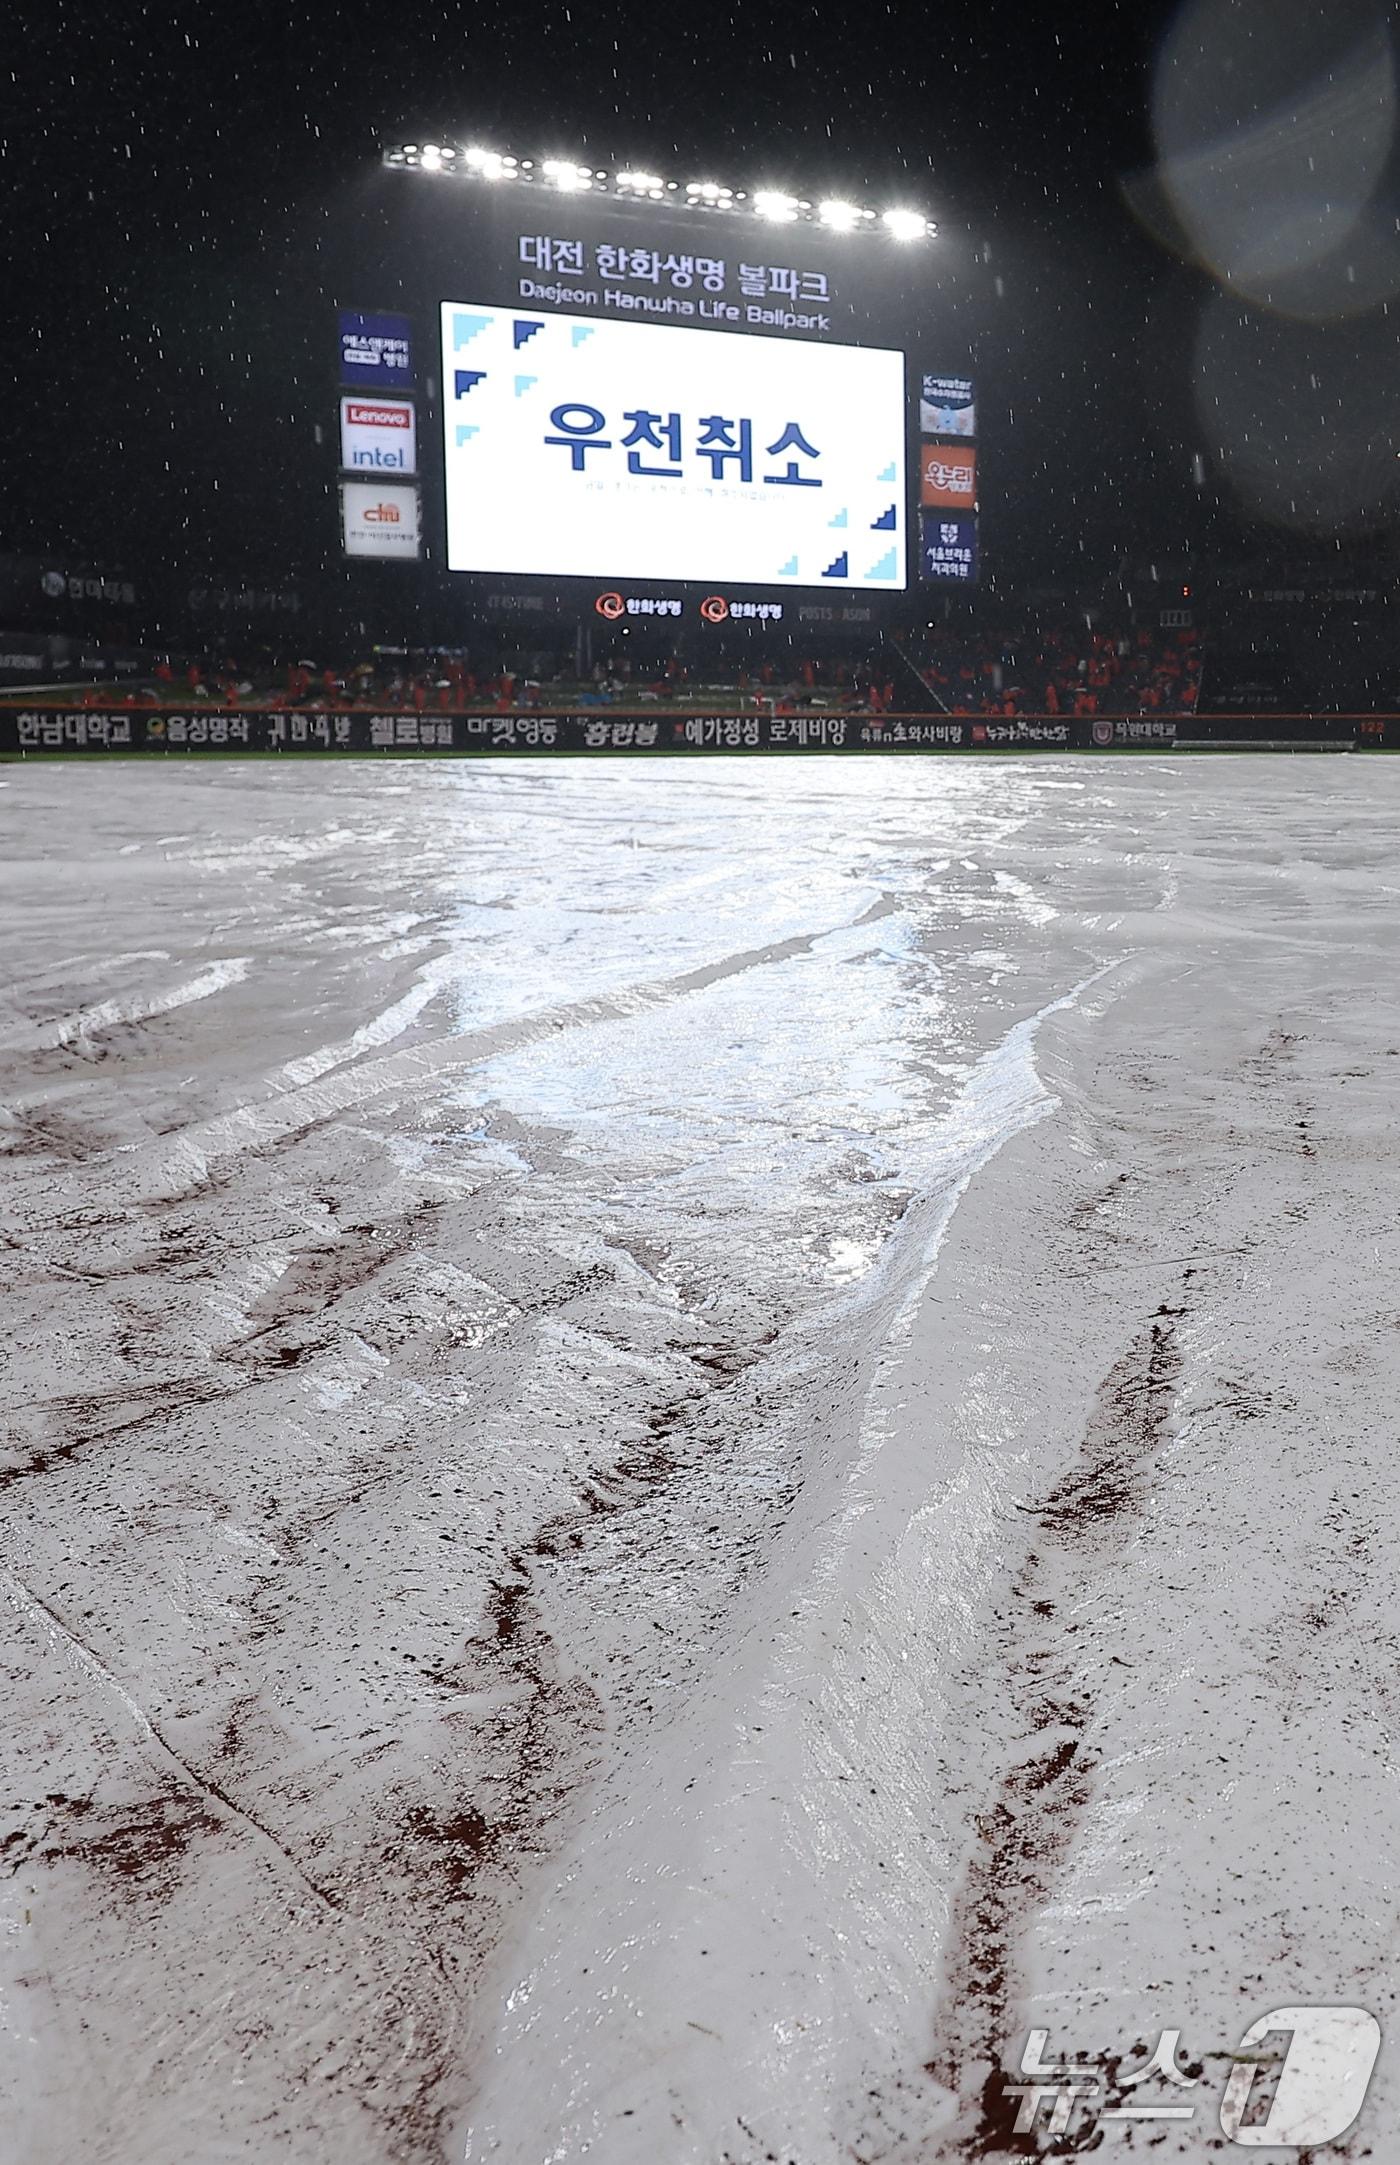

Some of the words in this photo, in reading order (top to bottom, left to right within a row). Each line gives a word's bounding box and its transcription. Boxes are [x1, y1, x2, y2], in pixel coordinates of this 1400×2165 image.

[519, 235, 585, 275] 대전
[595, 244, 725, 292] 한화생명
[738, 263, 831, 302] 볼파크
[519, 278, 597, 307] Daejeon
[604, 288, 694, 316] Hanwha
[699, 300, 740, 321] Life
[746, 304, 831, 331] Ballpark
[350, 407, 407, 425] Lenovo
[353, 445, 403, 468] intel
[544, 402, 822, 487] 우천취소
[626, 598, 682, 617] 한화생명
[729, 601, 783, 619] 한화생명
[16, 713, 132, 746] 한남대학교
[167, 715, 249, 743] 음성명작
[685, 716, 760, 746] 예가정성
[769, 717, 848, 747] 로제비앙
